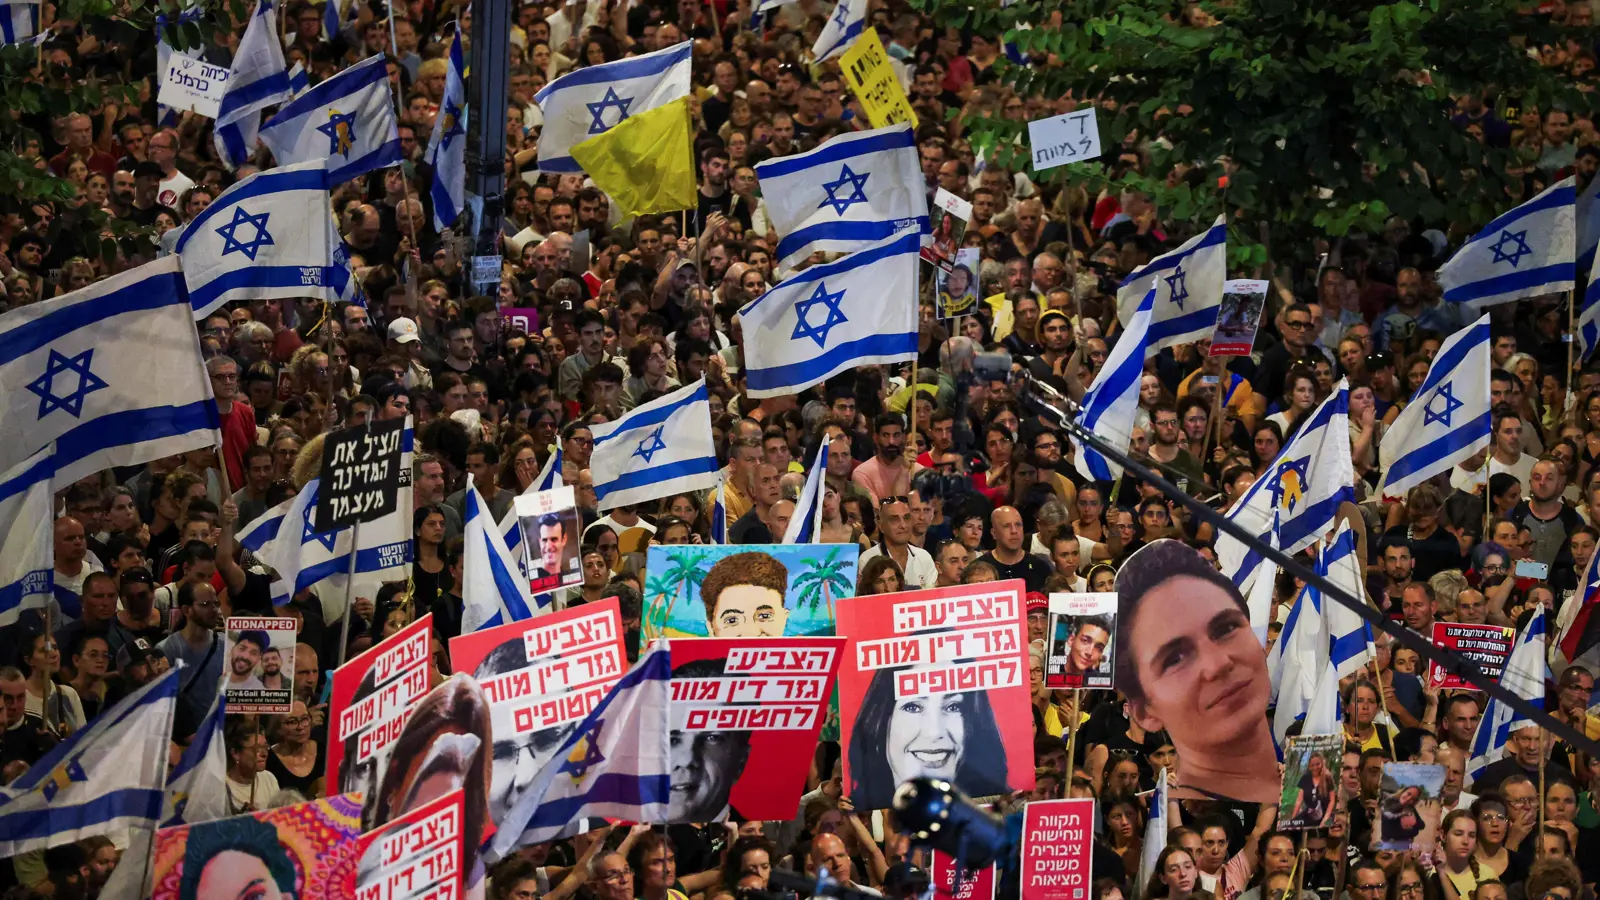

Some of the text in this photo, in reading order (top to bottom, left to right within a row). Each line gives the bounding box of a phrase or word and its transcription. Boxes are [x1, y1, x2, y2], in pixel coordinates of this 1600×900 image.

[1061, 114, 1090, 134] די
[330, 429, 400, 466] תציל את
[332, 460, 389, 490] המדינה
[330, 490, 384, 521] מעצמך
[379, 554, 405, 567] ארצנו
[230, 620, 293, 629] KIDNAPPED
[900, 595, 1014, 629] הצביעה:
[527, 616, 612, 657] הצביע:
[861, 629, 1016, 667] גזר דין מוות
[377, 633, 426, 682] הצביע:
[577, 651, 617, 678] גזר
[728, 651, 829, 671] הצביע:
[538, 662, 570, 695] דין
[726, 680, 768, 703] דין
[777, 680, 819, 699] גזר
[899, 660, 1017, 696] לחטופים
[342, 668, 425, 736] גזר דין מוות
[686, 707, 814, 729] לחטופים
[360, 709, 414, 759] טופים
[1039, 814, 1080, 829] תקווה
[383, 811, 454, 866] הצביע:
[1030, 830, 1083, 842] ונחישות
[422, 848, 454, 880] גזר
[1030, 844, 1082, 857] ציבורית
[1031, 873, 1082, 886] מציאות
[1035, 859, 1079, 872] משנים
